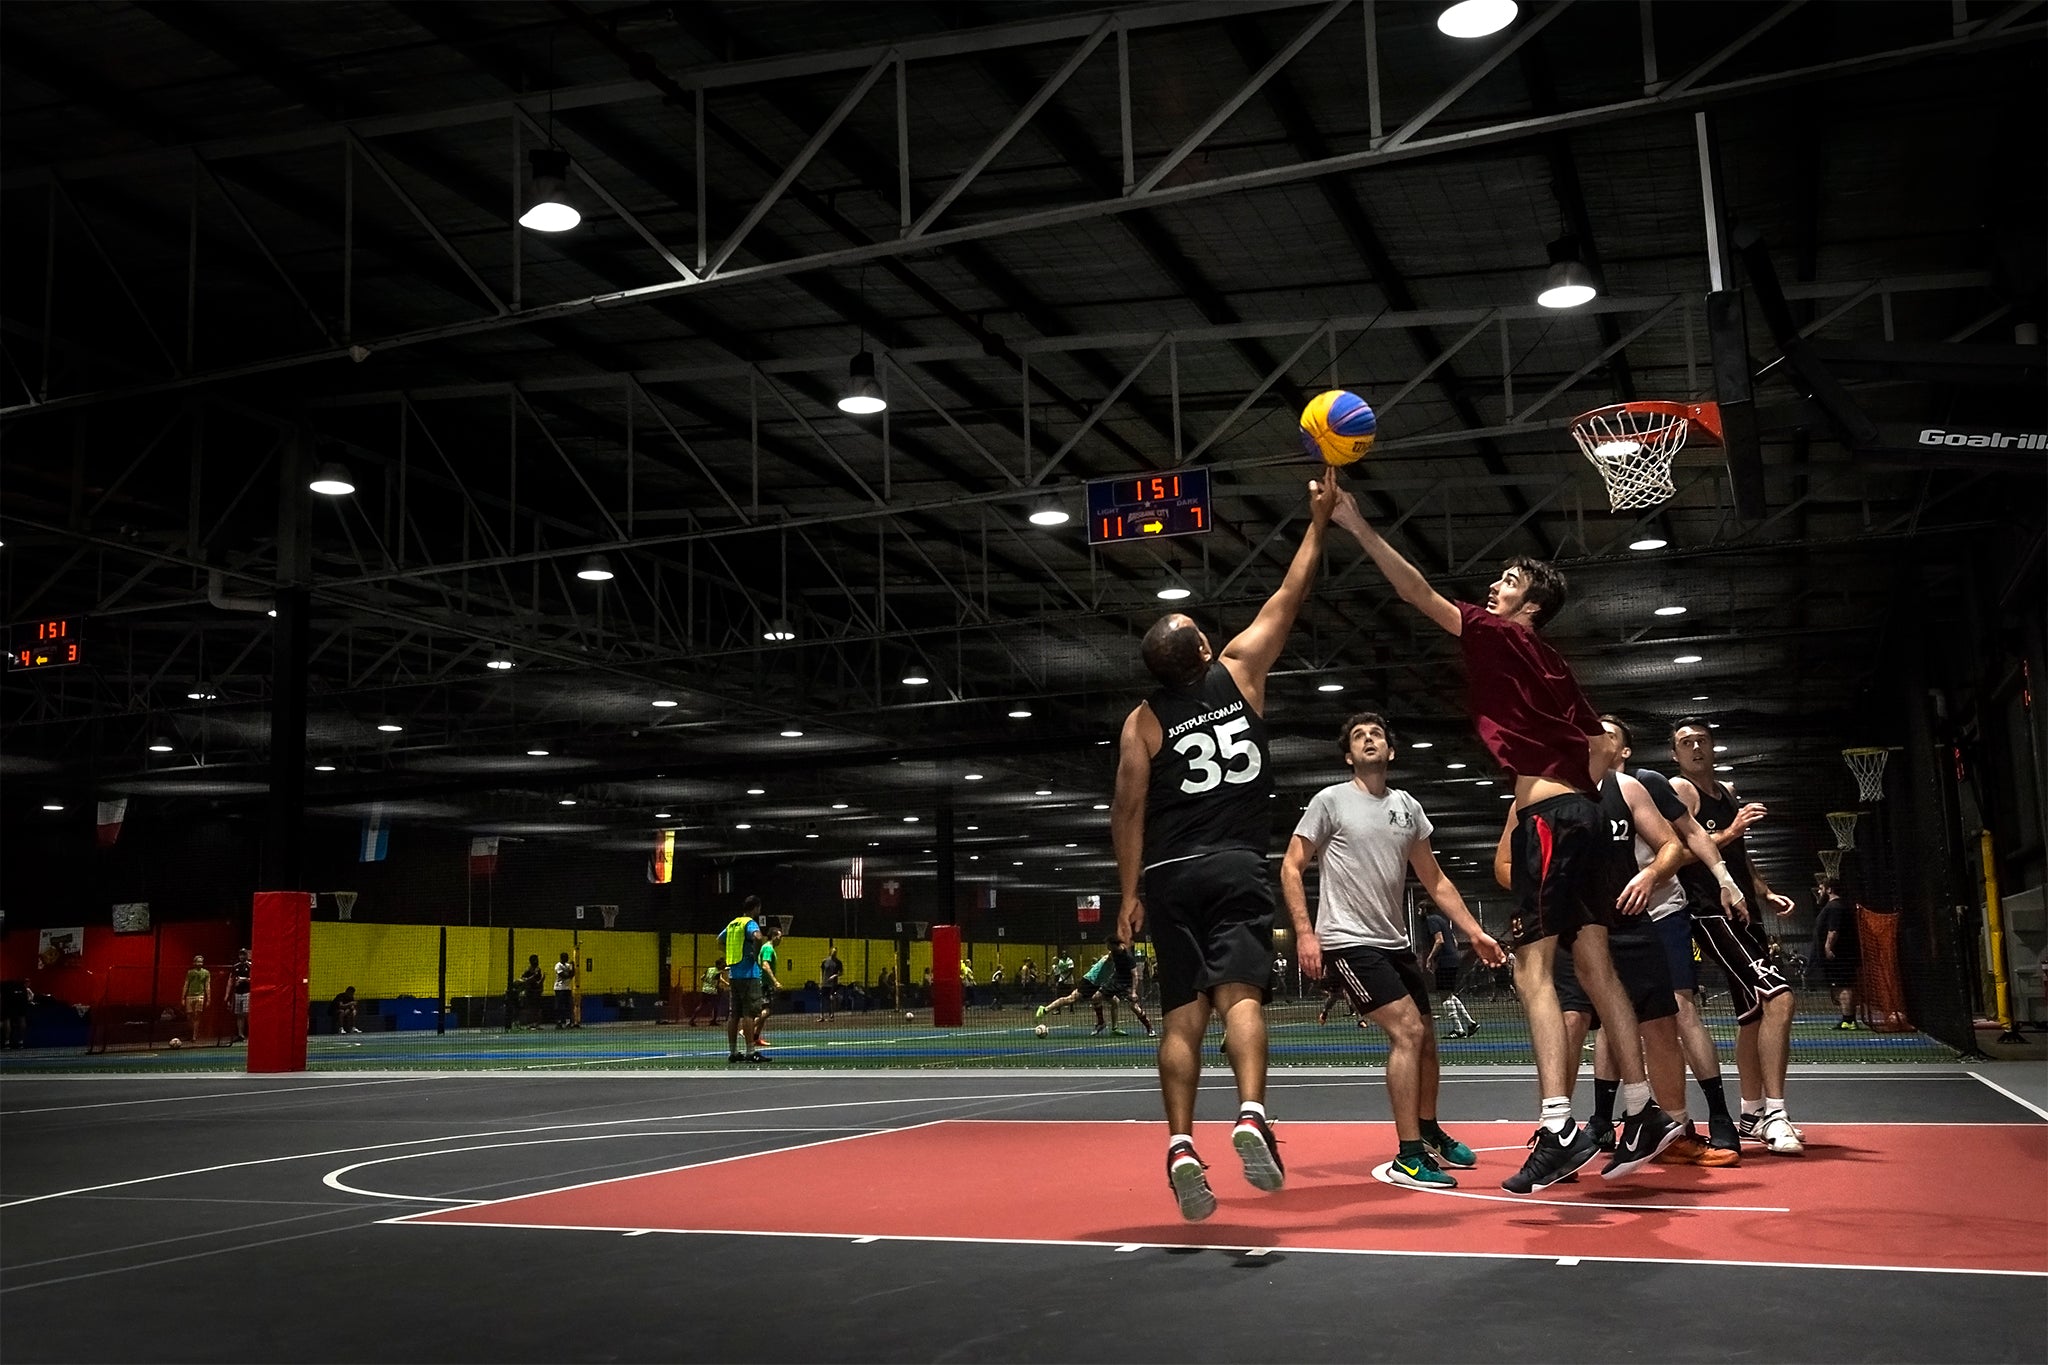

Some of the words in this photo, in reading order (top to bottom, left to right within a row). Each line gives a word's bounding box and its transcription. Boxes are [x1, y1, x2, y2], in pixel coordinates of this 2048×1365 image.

[1919, 429, 2048, 450] Goalrill
[1176, 498, 1199, 506] DARK
[1097, 508, 1120, 516] LIGHT
[1190, 507, 1202, 528] 7
[1103, 516, 1122, 538] 11
[21, 650, 30, 666] 4
[68, 644, 77, 661] 3
[1173, 715, 1262, 794] 35
